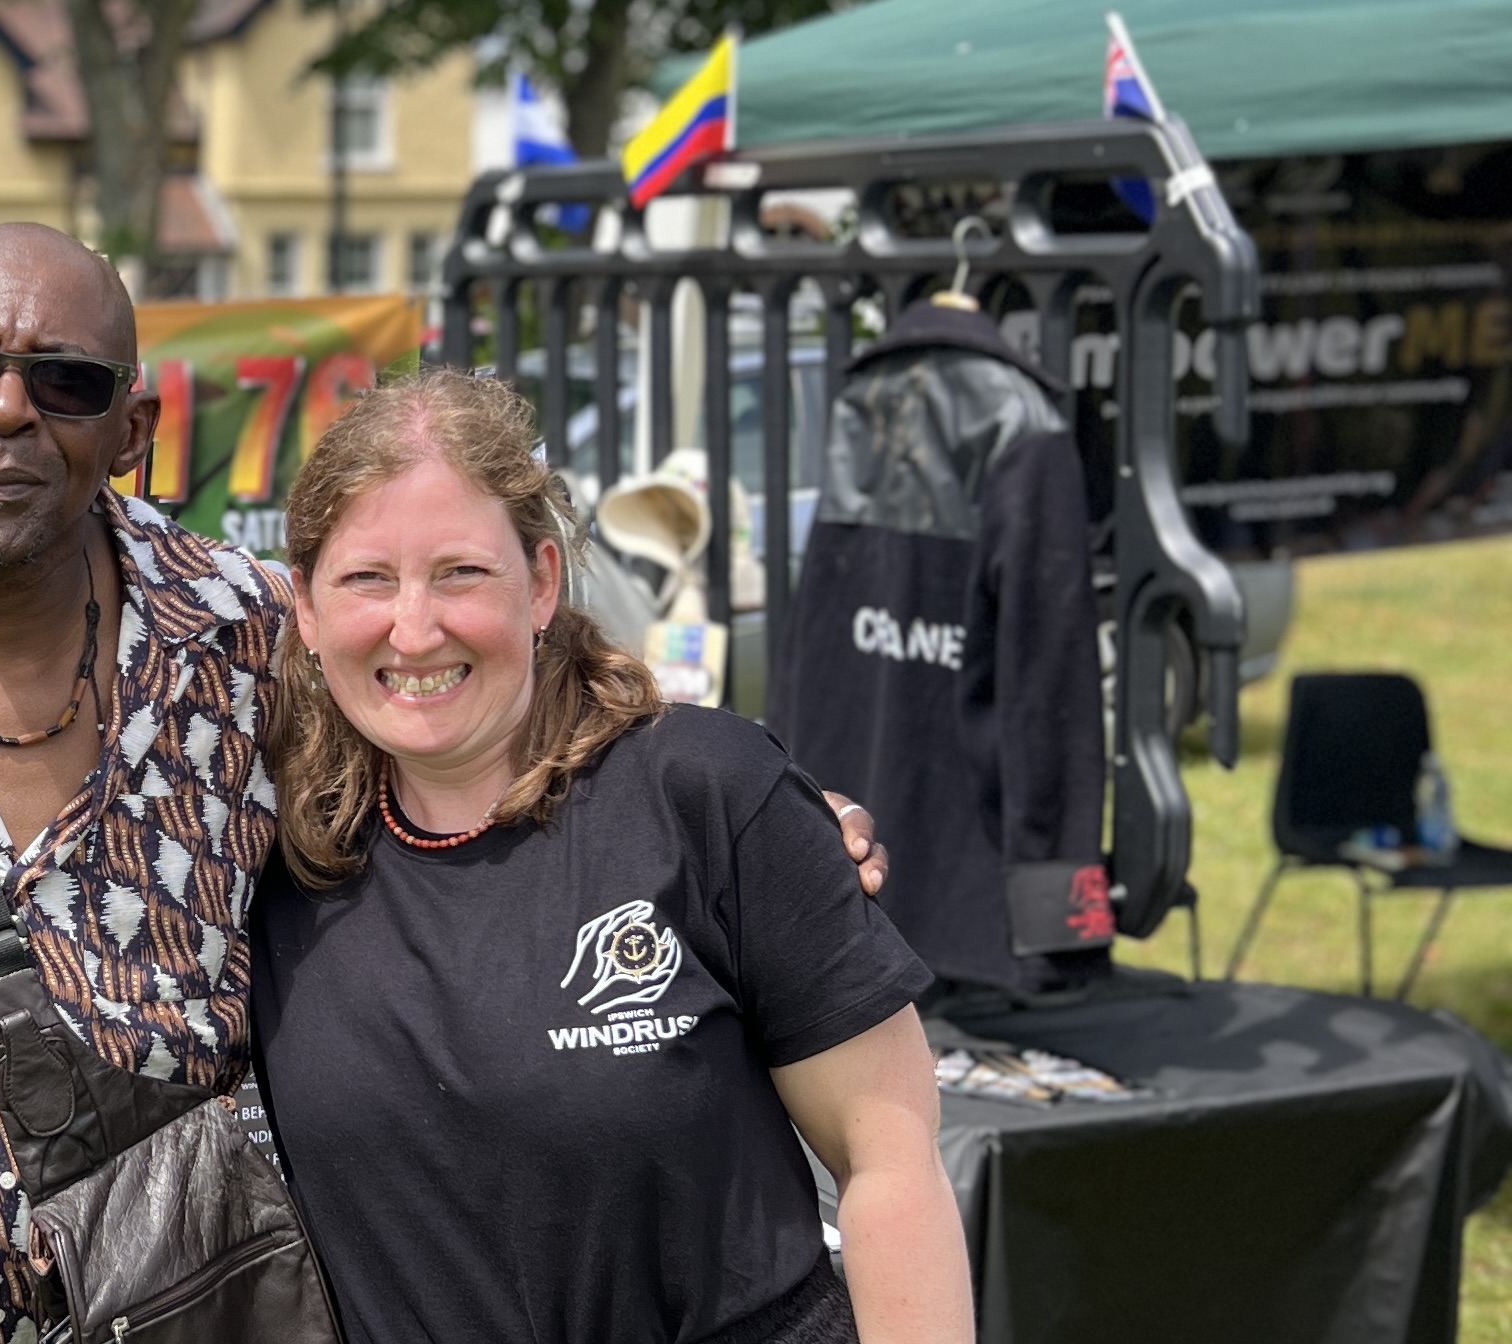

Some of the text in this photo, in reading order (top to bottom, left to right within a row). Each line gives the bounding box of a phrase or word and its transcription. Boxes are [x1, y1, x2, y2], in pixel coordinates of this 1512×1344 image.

[607, 1008, 654, 1021] IPSWICH
[548, 1015, 699, 1050] WINDRUS
[613, 1042, 660, 1055] SOCIETY
